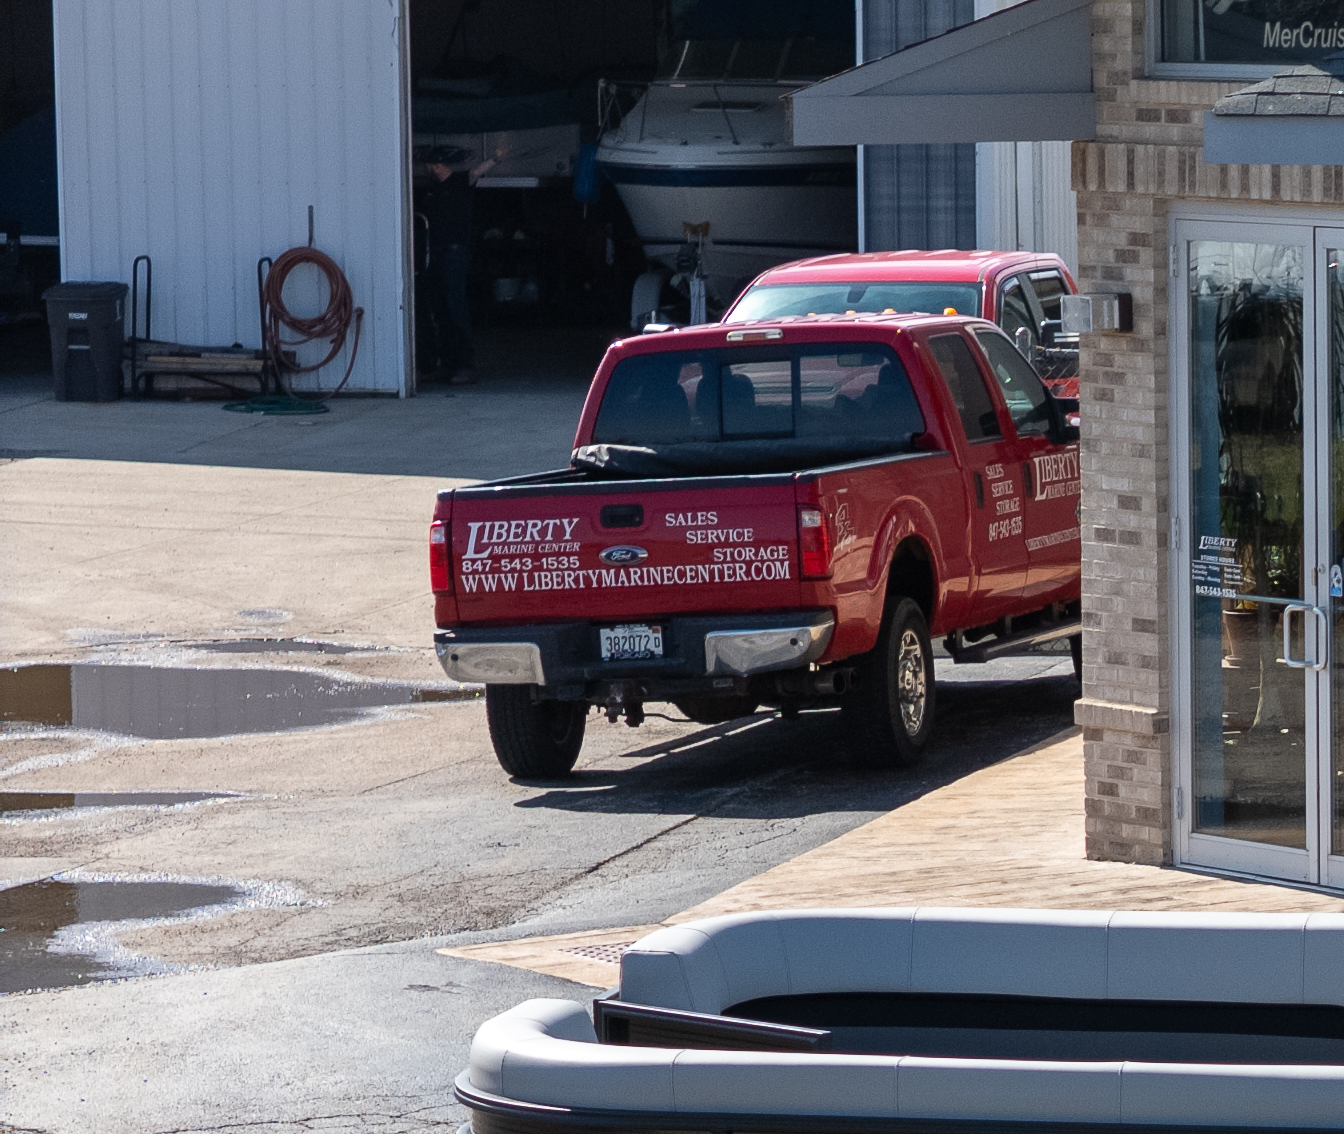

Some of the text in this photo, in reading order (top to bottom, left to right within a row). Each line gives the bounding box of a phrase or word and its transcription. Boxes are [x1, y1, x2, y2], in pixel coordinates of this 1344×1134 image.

[1033, 451, 1078, 501] LIBERTY
[665, 511, 718, 527] SALES
[462, 518, 579, 559] LIBERTY
[686, 528, 754, 544] SERVICE
[1199, 536, 1237, 550] LIBERTY
[492, 542, 580, 555] MARINE CENTER
[714, 545, 789, 562] STORAGE
[462, 556, 580, 573] 847-543-1535
[461, 561, 790, 593] WWW LIBERTYMARINECENTER.COM
[605, 634, 651, 652] 382072
